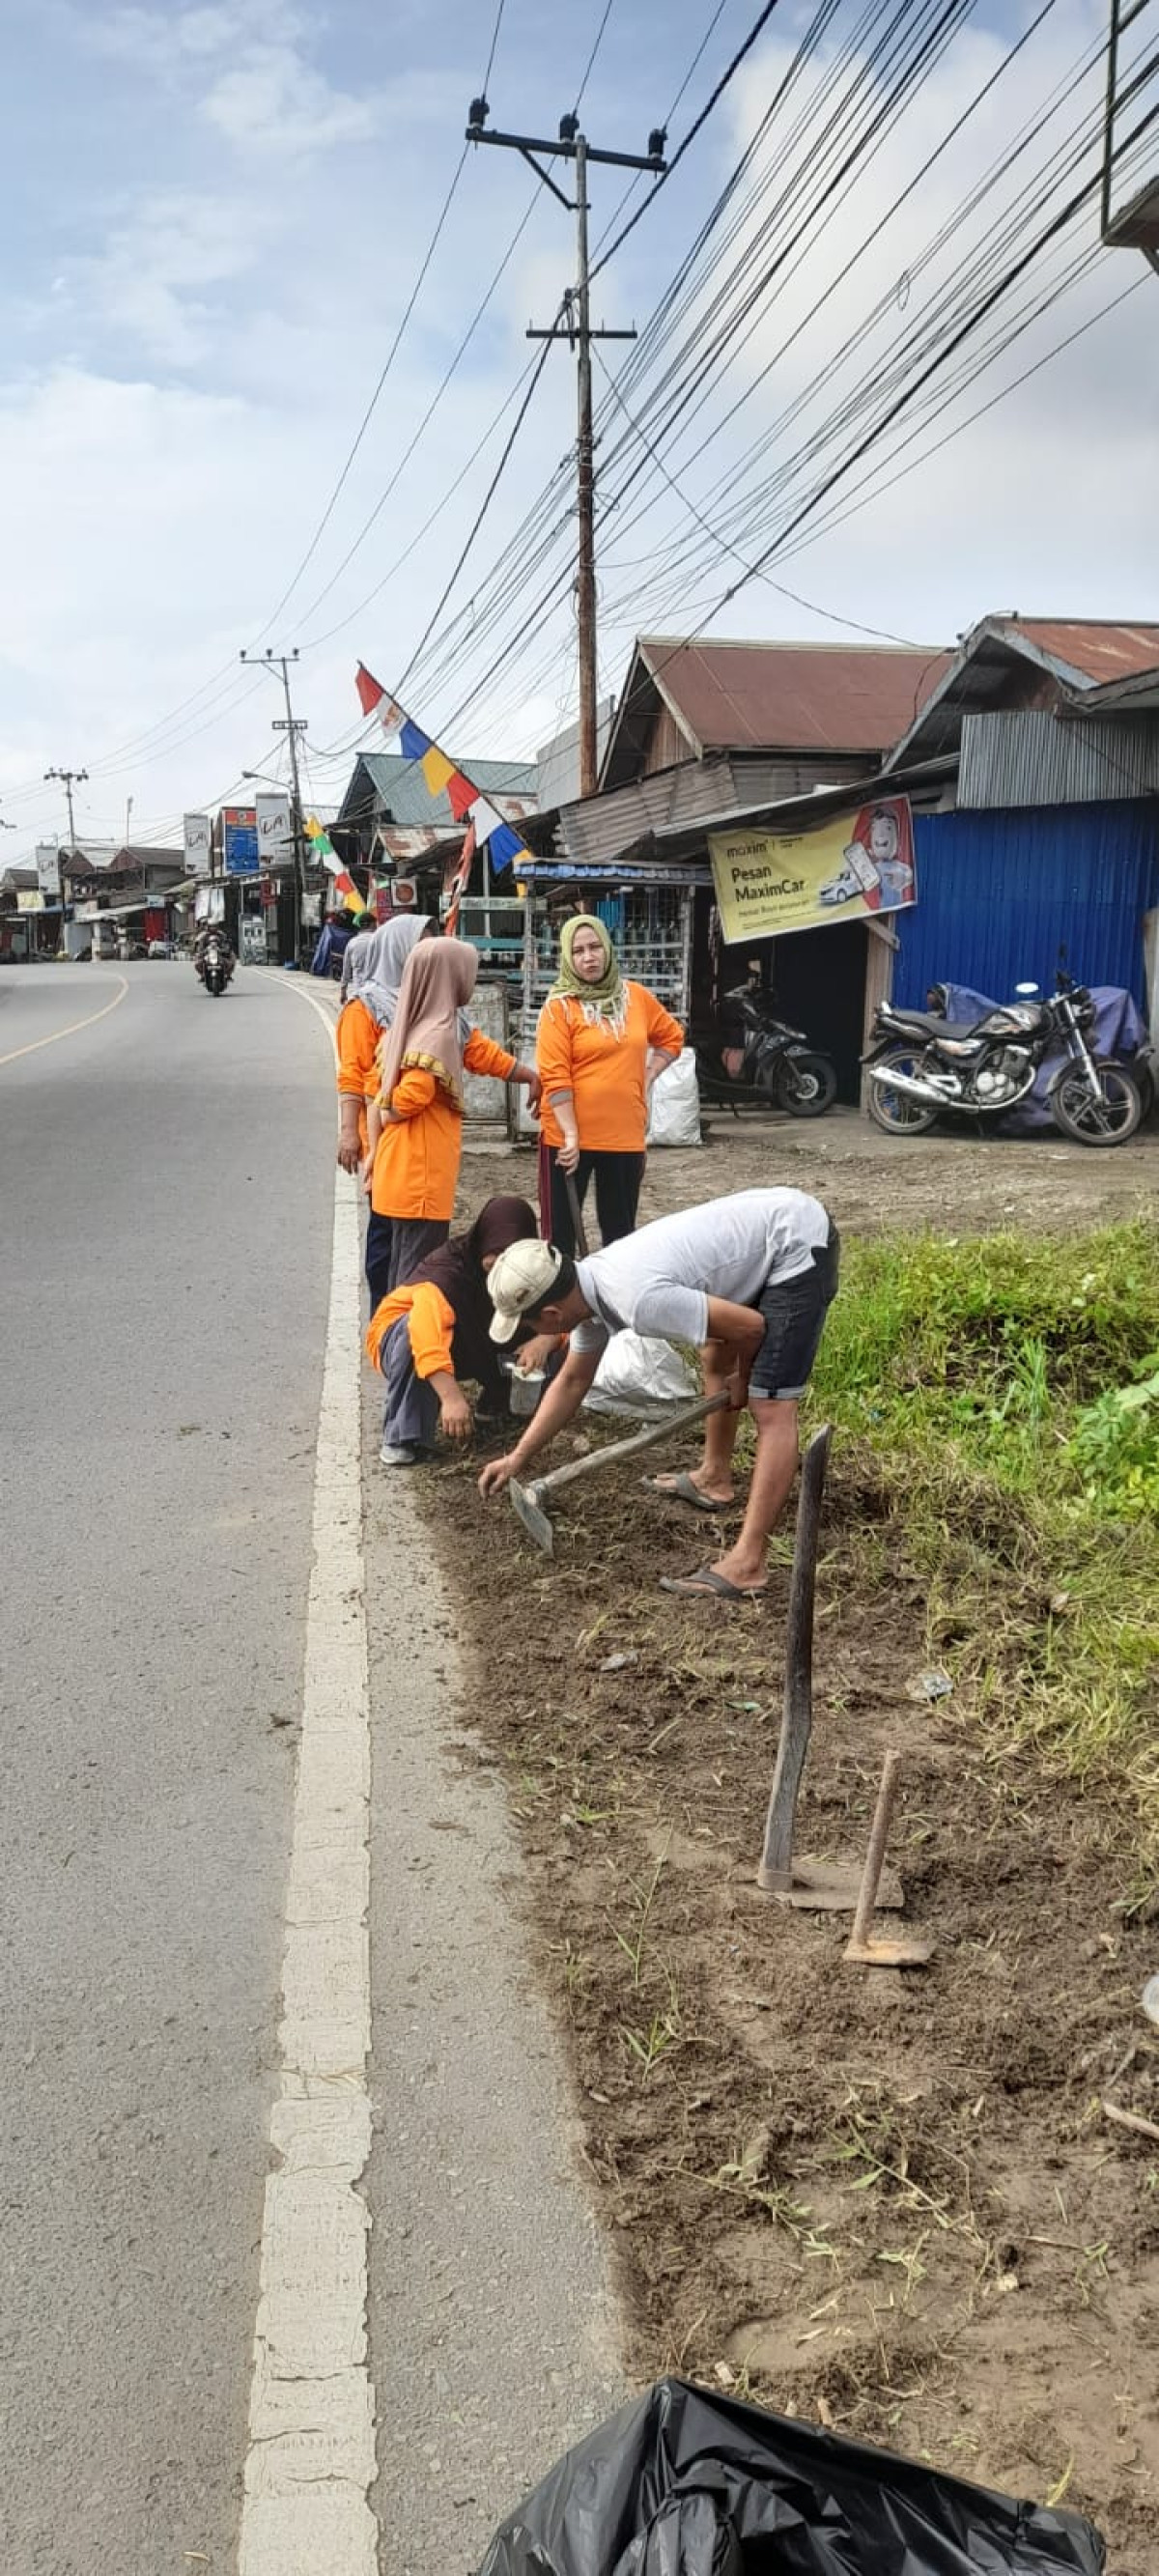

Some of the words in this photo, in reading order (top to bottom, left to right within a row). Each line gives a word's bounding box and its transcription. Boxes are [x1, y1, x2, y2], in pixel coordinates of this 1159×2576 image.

[726, 842, 767, 859] maxim
[731, 865, 771, 883] Pesan
[735, 879, 805, 902] MaximCar
